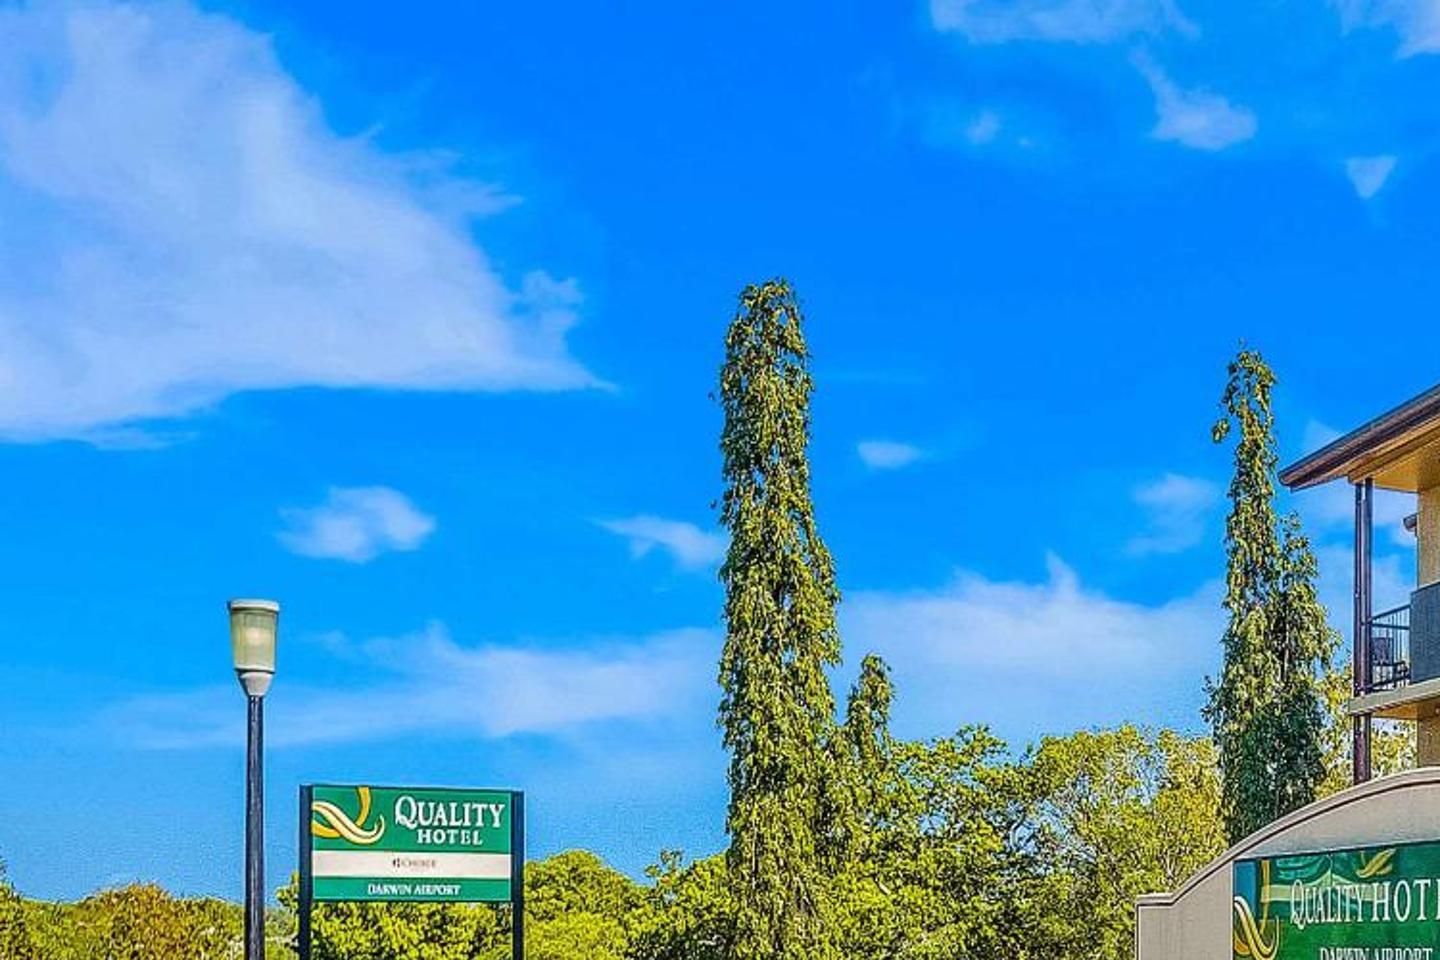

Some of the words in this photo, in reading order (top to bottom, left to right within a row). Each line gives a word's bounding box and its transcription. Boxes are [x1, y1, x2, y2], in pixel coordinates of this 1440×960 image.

[394, 795, 505, 829] QUALITY
[417, 829, 484, 846] HOTEL
[367, 884, 412, 896] DARWIN
[414, 884, 461, 896] AIRPORT
[1289, 879, 1367, 930] QUALITY
